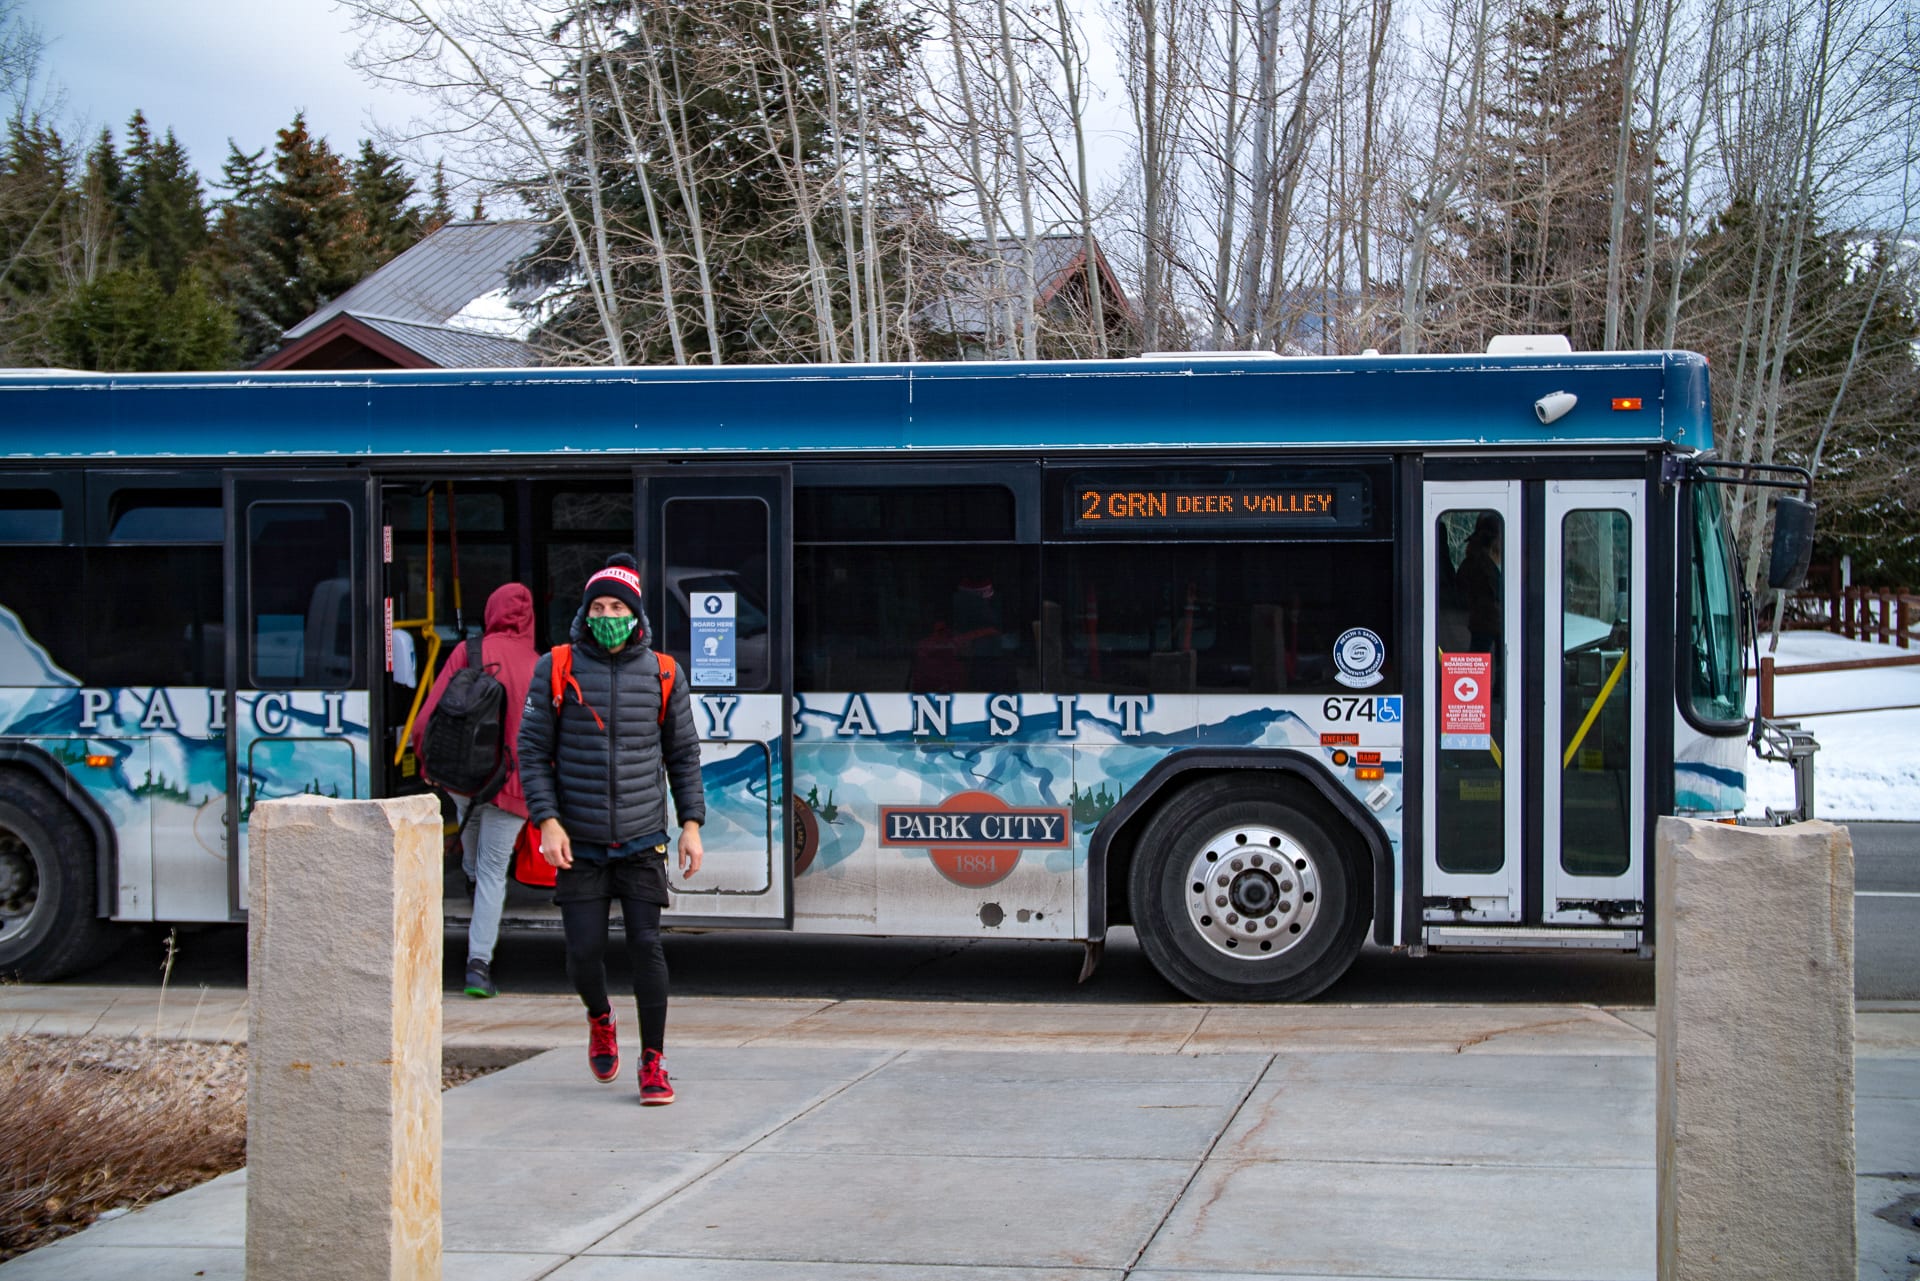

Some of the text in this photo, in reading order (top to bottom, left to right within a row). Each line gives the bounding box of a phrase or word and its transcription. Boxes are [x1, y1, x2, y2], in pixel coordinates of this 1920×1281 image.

[1081, 491, 1332, 519] 2 GRN DEER VALLEY
[1339, 631, 1357, 645] HEALTH
[1362, 631, 1379, 645] SAFETY
[1323, 697, 1376, 722] 674
[1322, 735, 1357, 743] KNEELING
[890, 815, 1060, 840] PARK CITY
[955, 855, 997, 873] 1884
